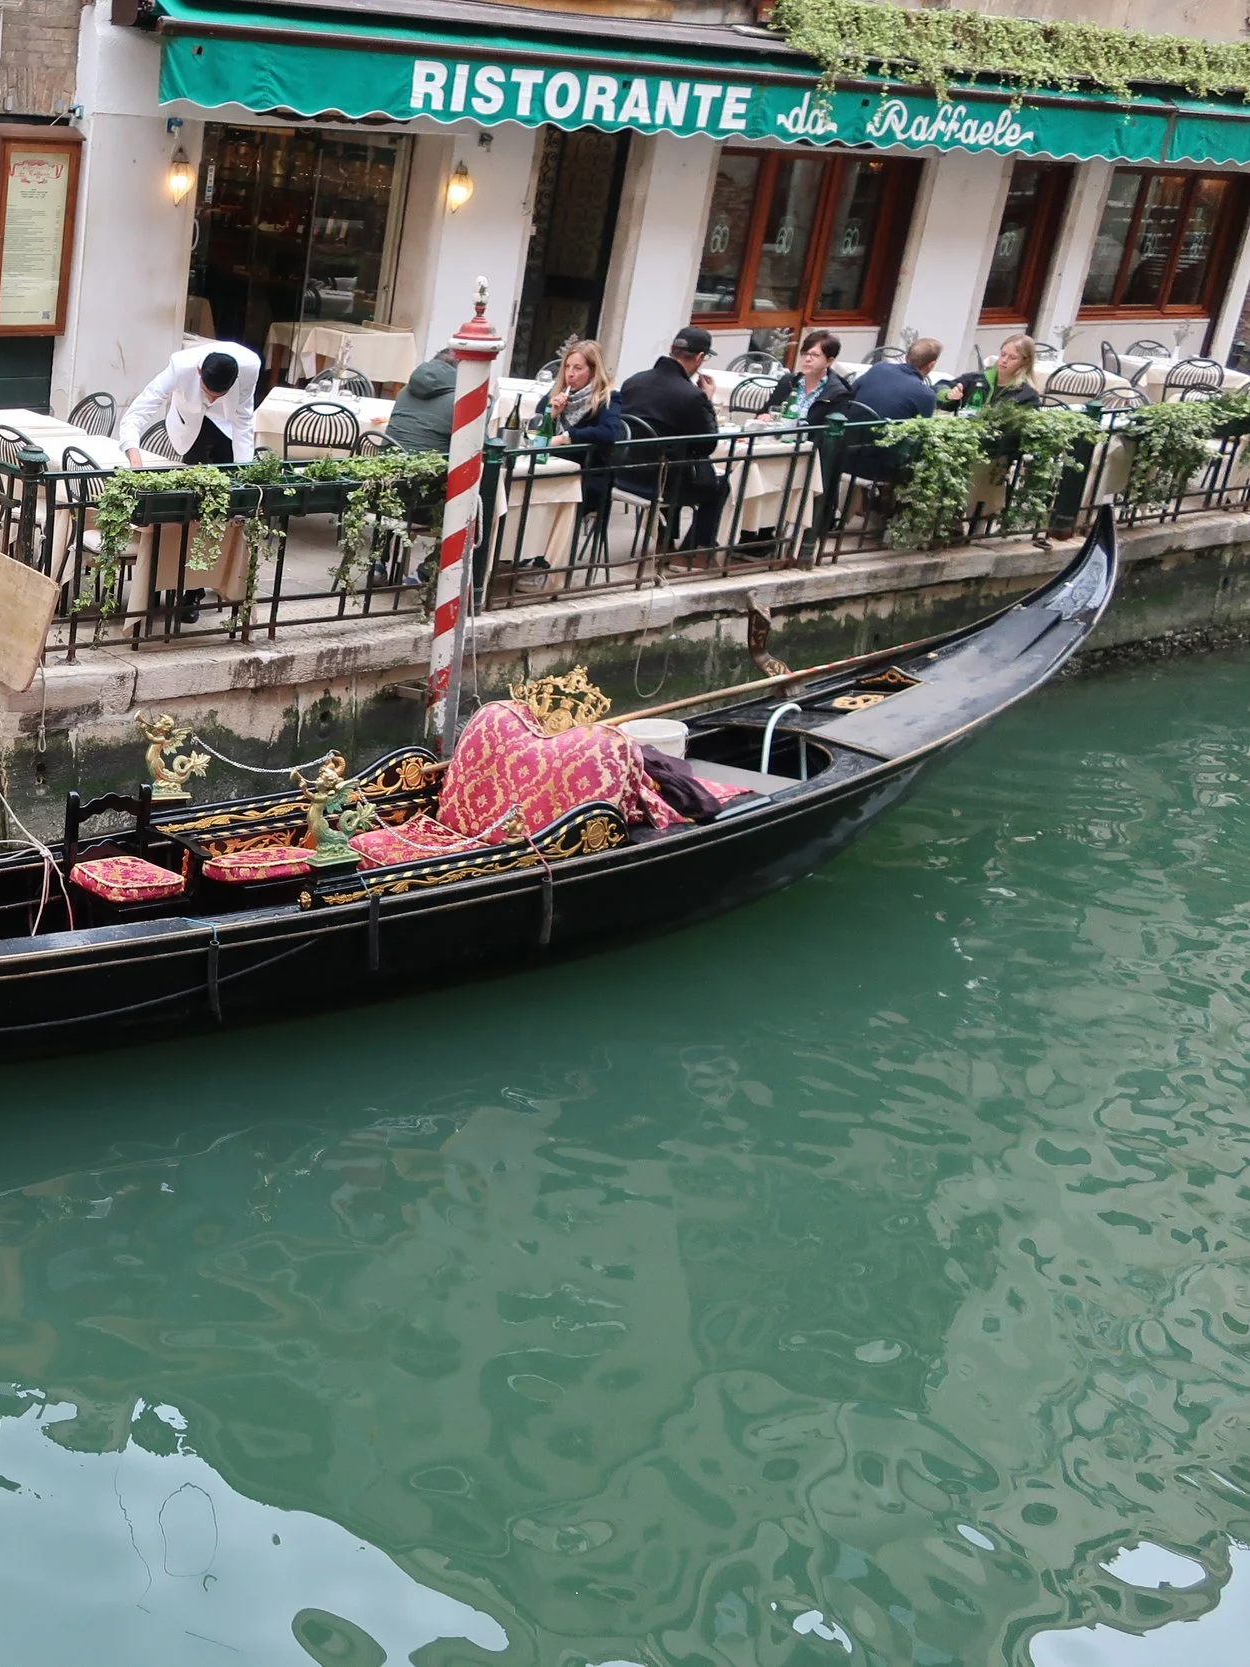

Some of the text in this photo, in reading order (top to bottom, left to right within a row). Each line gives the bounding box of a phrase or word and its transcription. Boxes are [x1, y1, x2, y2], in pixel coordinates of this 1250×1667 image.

[410, 59, 1035, 147] RISTORANTE da Raffaele
